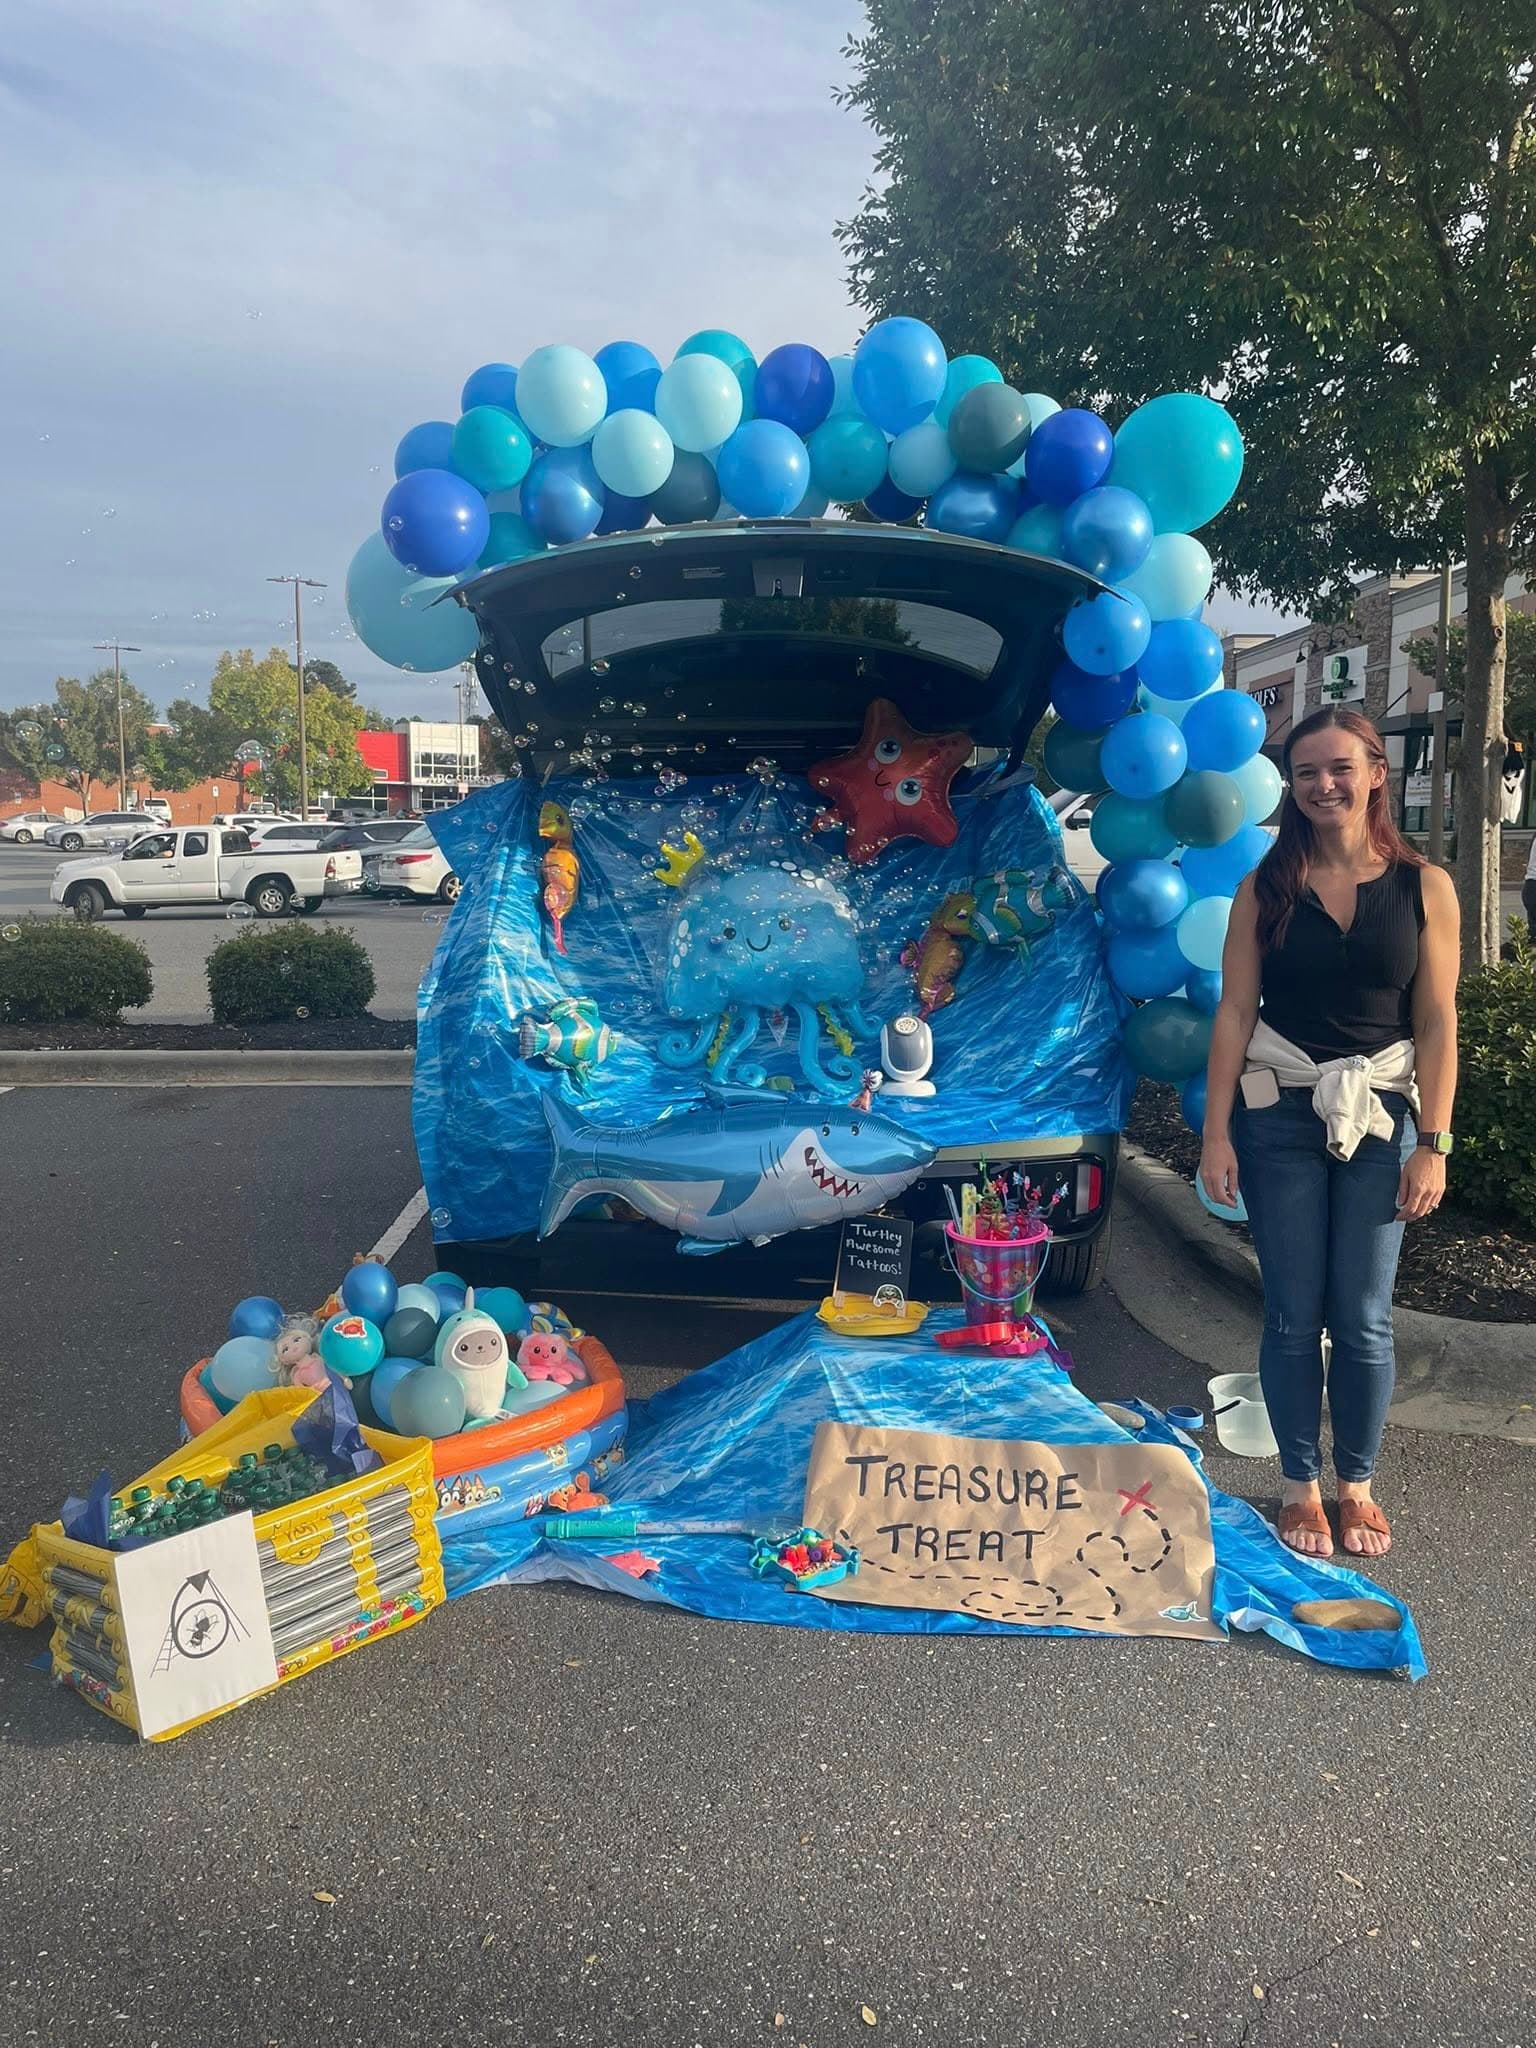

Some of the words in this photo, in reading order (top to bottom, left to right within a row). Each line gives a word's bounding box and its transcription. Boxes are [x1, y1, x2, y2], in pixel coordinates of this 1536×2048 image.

[427, 773, 454, 784] ABC
[845, 1238, 901, 1256] Awesome
[850, 1223, 903, 1248] Turtley
[847, 1254, 903, 1275] Tattoos!
[845, 1455, 1083, 1511] TREASURE
[876, 1523, 1046, 1562] TREAT
